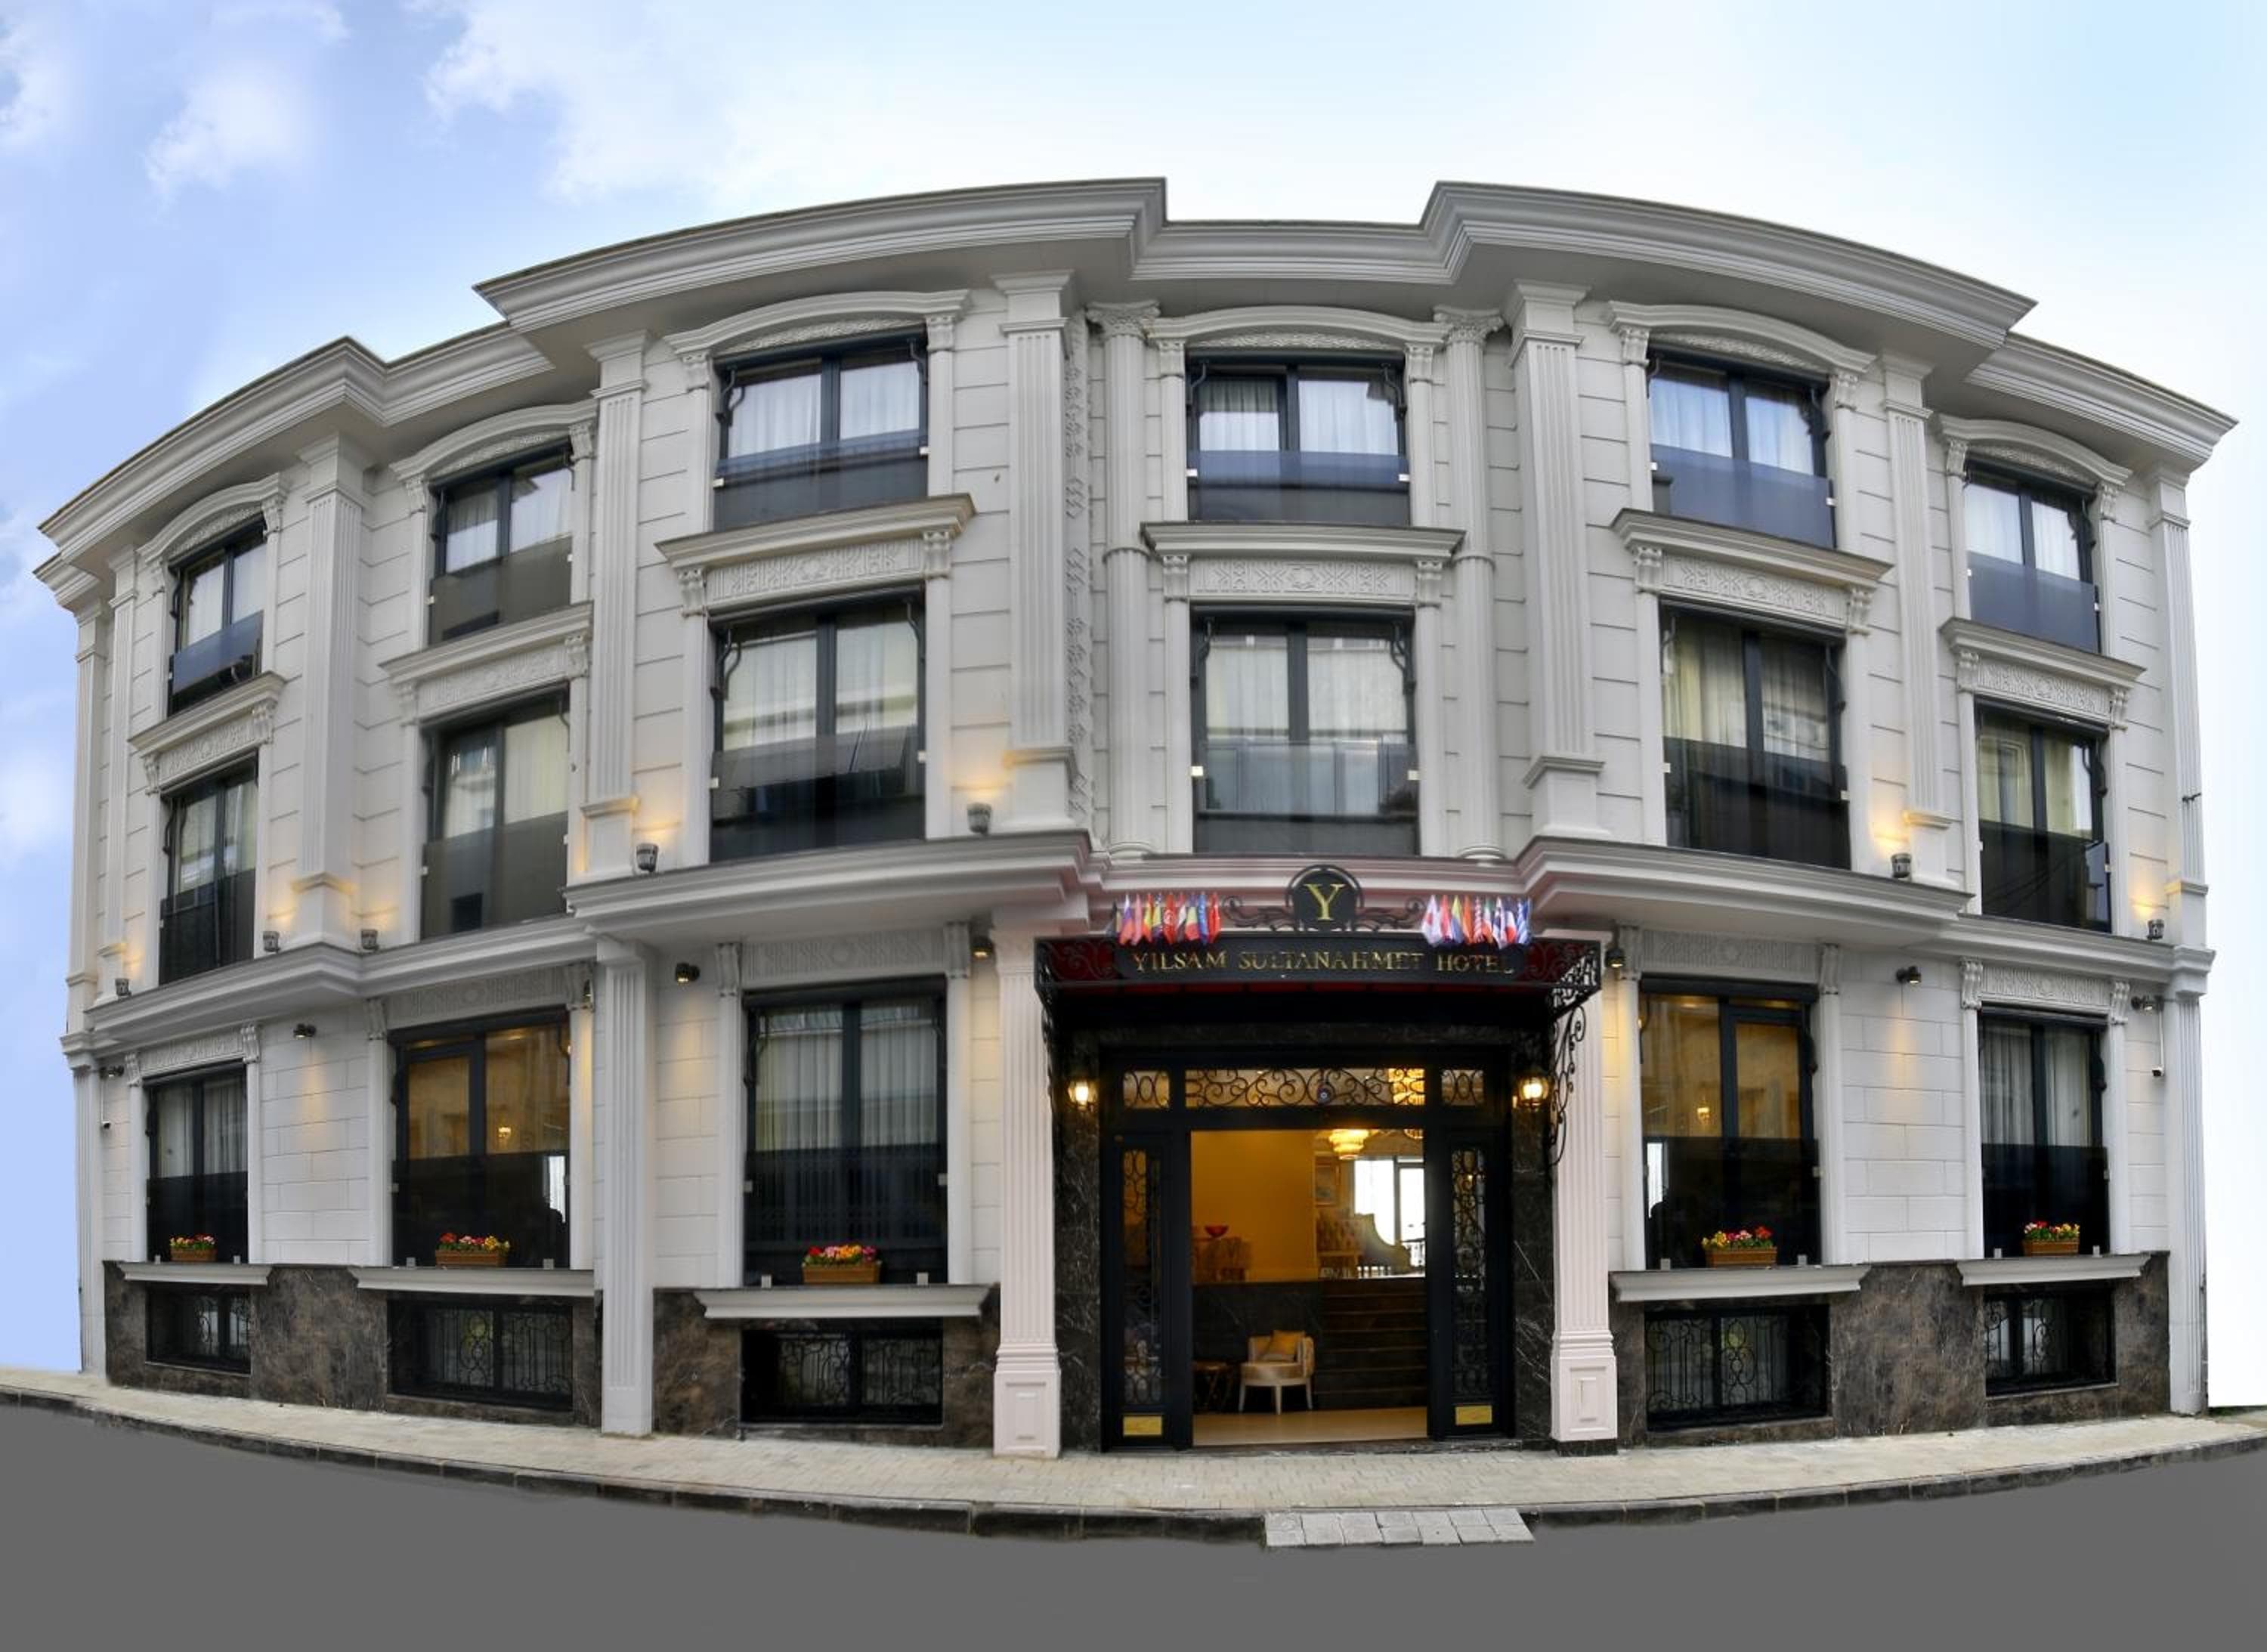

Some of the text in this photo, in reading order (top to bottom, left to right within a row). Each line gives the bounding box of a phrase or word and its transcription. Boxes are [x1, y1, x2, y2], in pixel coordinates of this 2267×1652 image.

[1303, 883, 1345, 921] Y
[1132, 951, 1514, 974] YILSAM SULTANAHMET HOTEL
